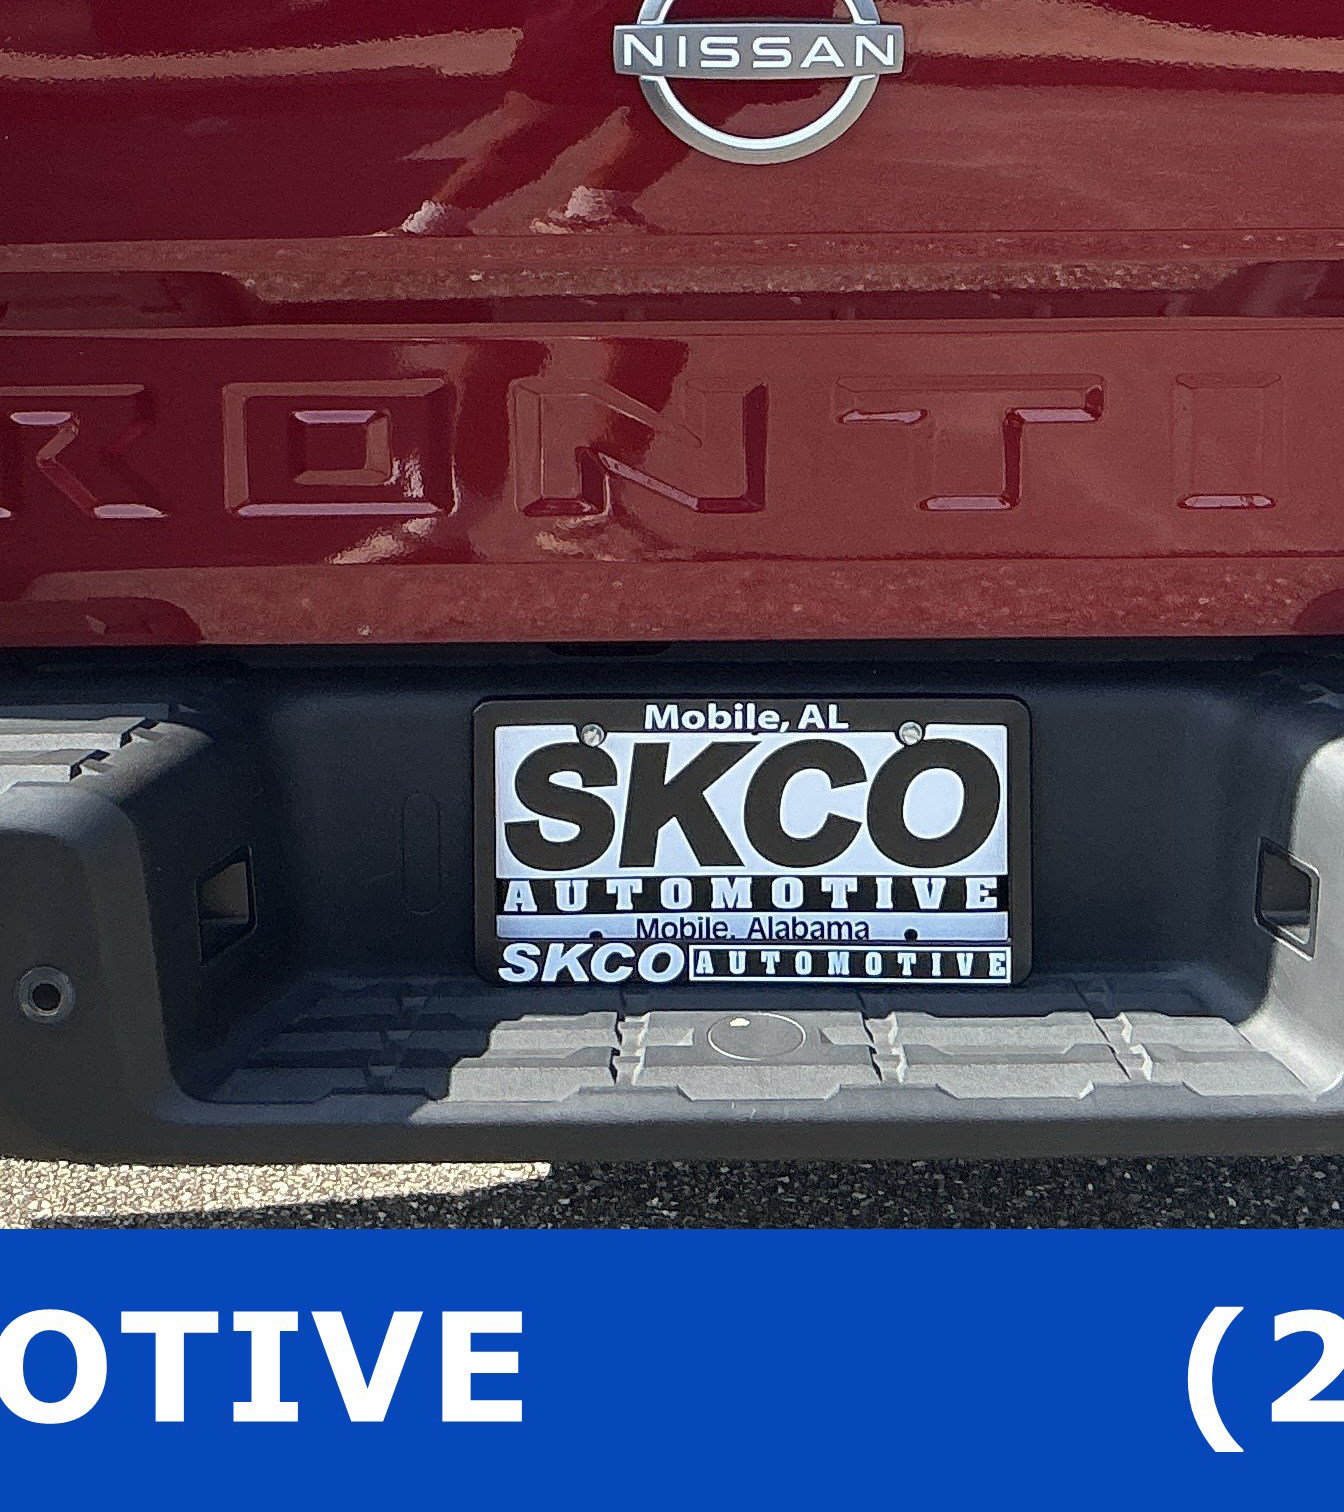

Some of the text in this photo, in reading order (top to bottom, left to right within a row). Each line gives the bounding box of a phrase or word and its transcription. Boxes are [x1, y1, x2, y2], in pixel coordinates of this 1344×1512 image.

[622, 34, 895, 69] NISSAN
[644, 703, 850, 733] Mobile, AL
[504, 738, 1001, 872] SKCO
[503, 876, 999, 912] AUTOMOTIVE
[747, 918, 870, 940] Alabama
[498, 942, 1006, 983] SKCO AUTOMOTIVE
